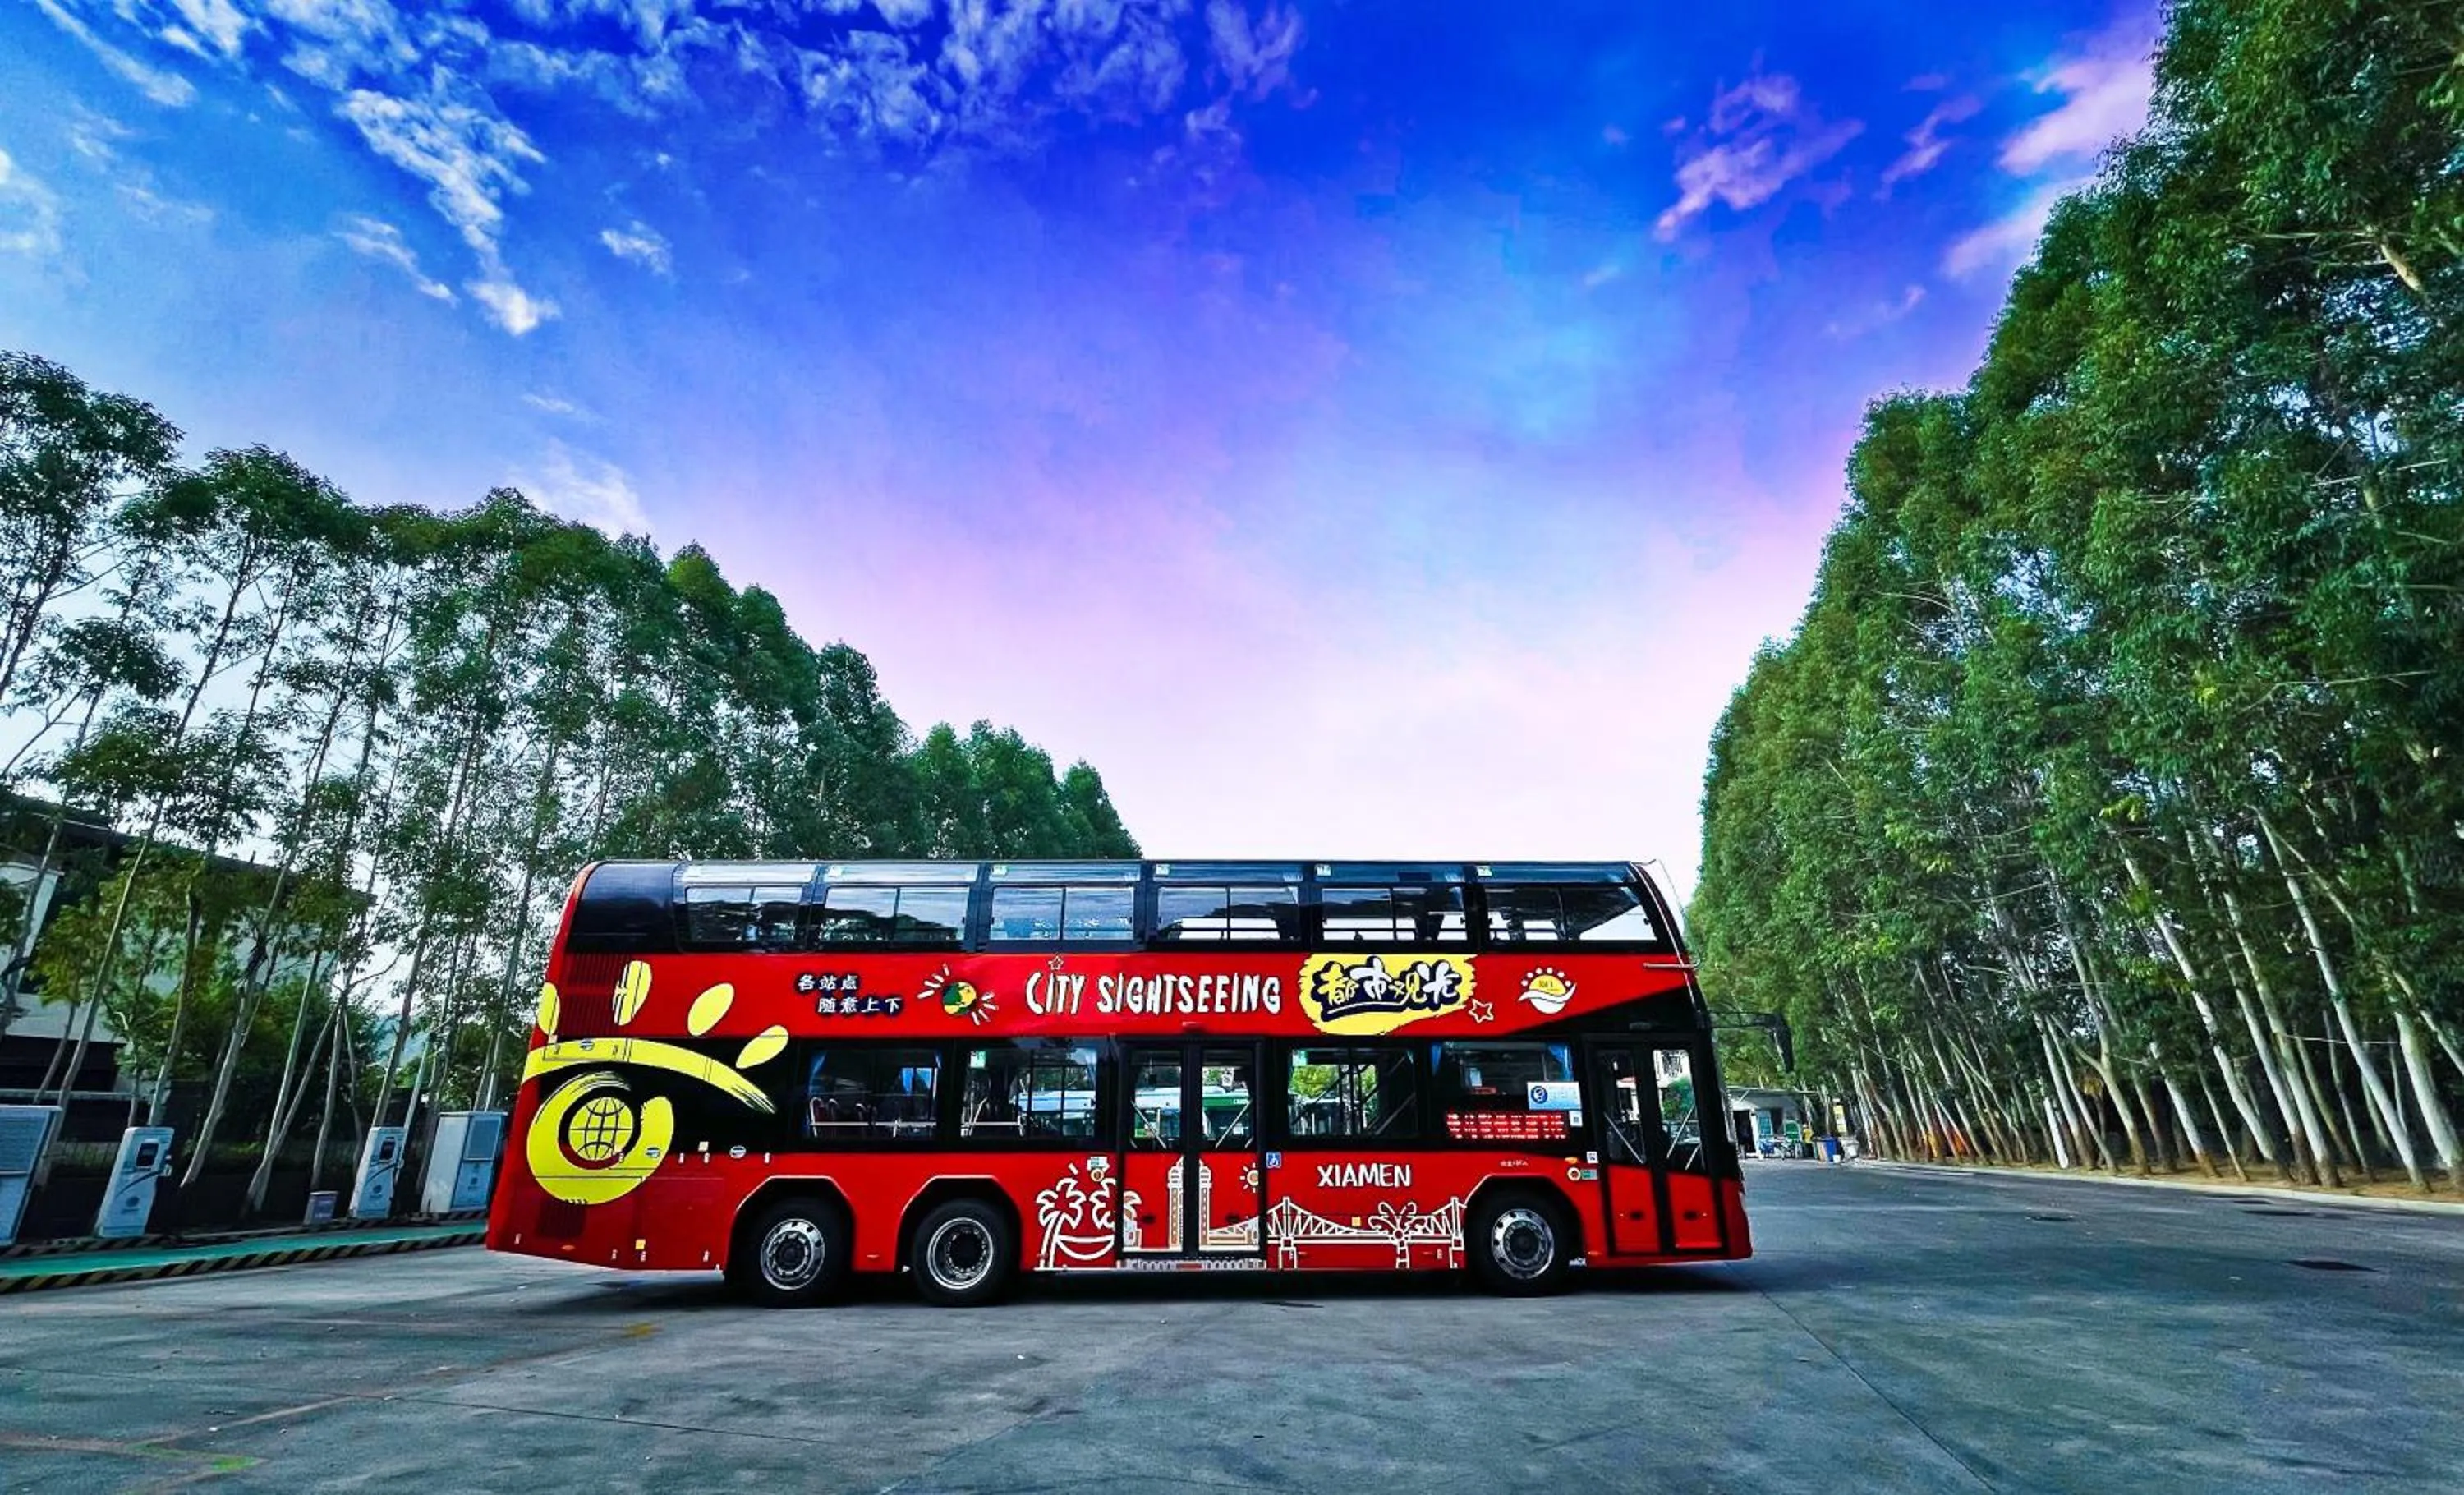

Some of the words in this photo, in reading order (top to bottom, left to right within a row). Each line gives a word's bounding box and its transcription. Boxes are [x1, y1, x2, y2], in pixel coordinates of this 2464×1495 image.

[797, 973, 859, 991] 各站点
[1026, 971, 1085, 1015] CITY
[1096, 972, 1281, 1015] SIGHTSEEING
[1314, 956, 1461, 1014] 都市观光
[816, 996, 903, 1014] 随意上下
[1316, 1162, 1412, 1188] XIAMEN
